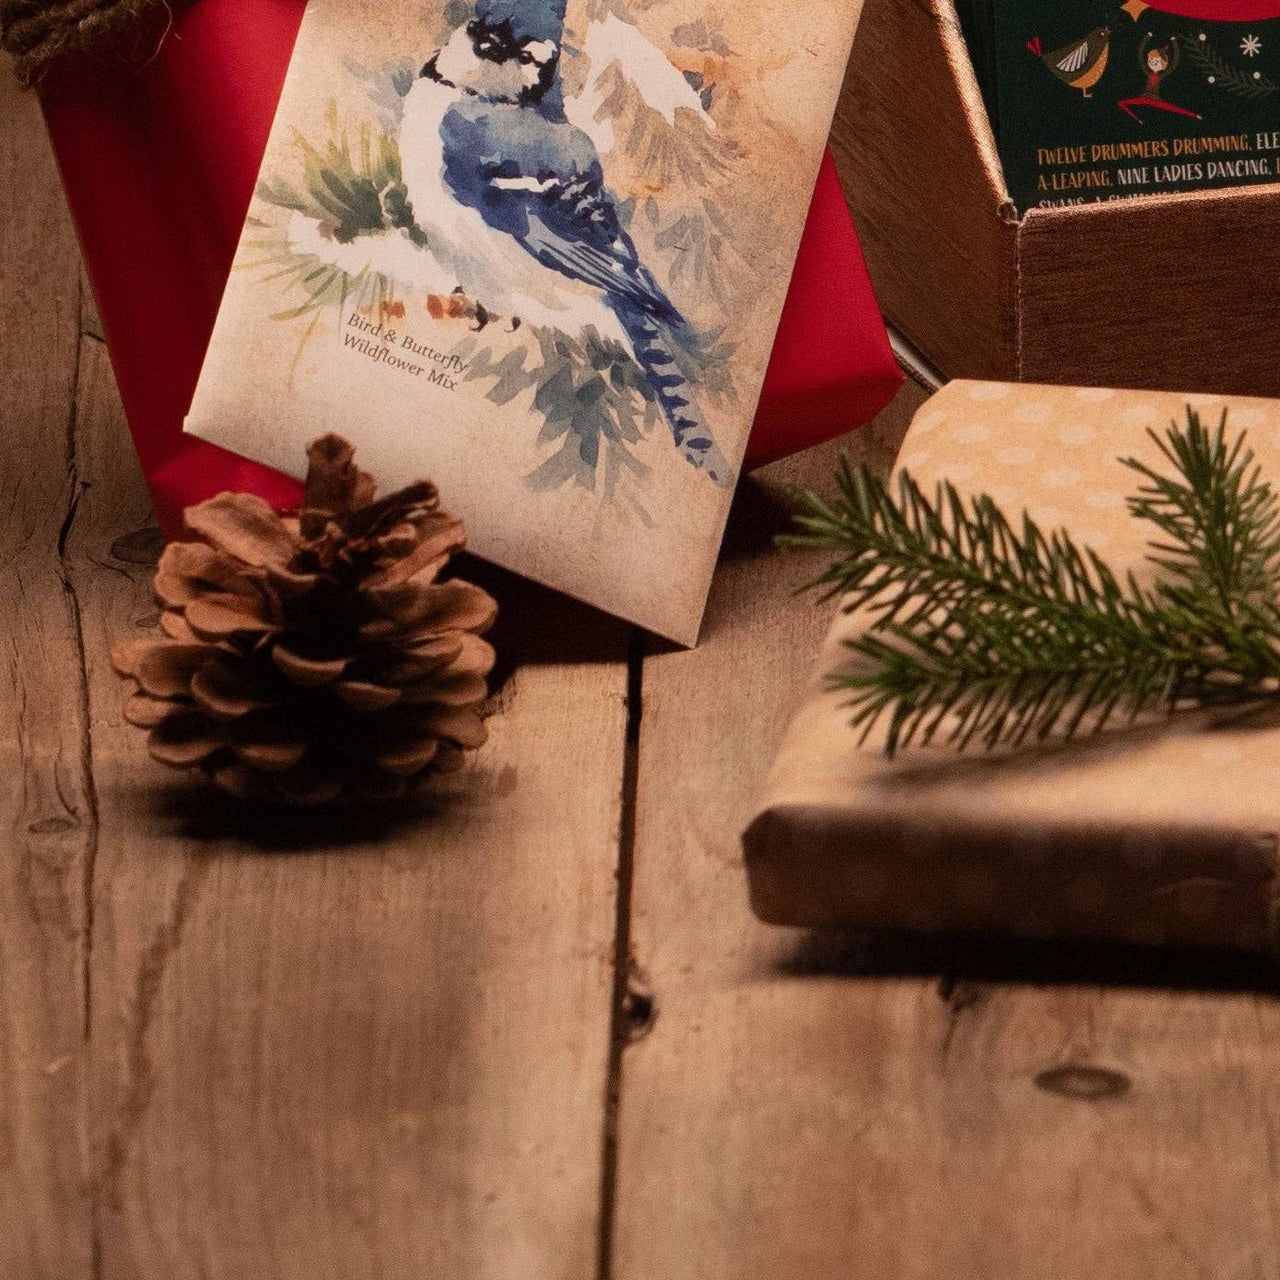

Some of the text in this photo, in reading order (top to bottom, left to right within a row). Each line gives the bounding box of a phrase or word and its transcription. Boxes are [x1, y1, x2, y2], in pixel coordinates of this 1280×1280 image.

[1037, 146, 1087, 166] TWELVE
[1091, 139, 1169, 163] DRUMMERS
[1117, 167, 1149, 185] NINE
[1153, 163, 1202, 183] LADIES
[344, 333, 459, 391] Wildflower Mix
[347, 313, 469, 374] Bird & Butterfly
